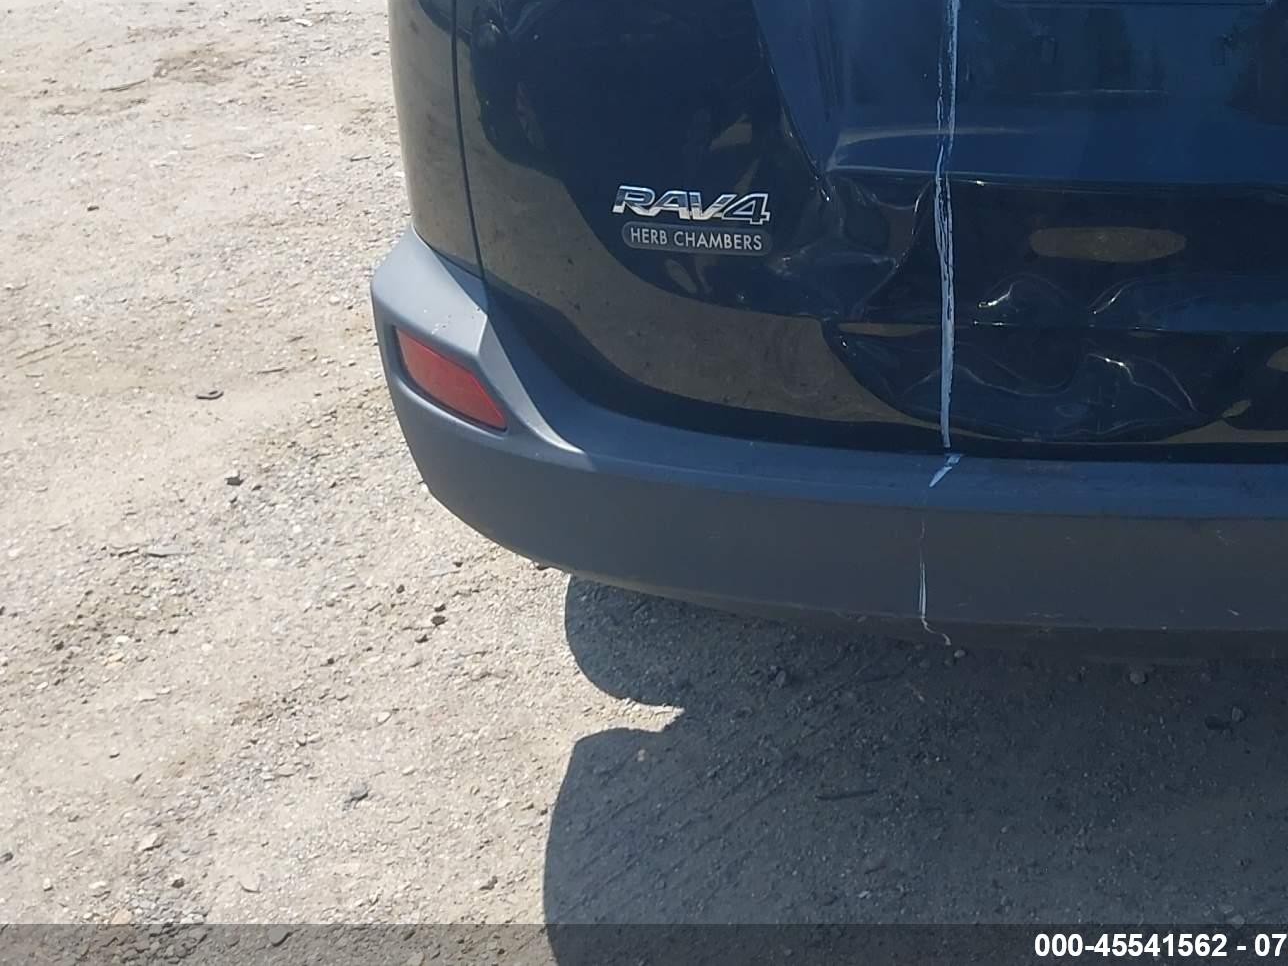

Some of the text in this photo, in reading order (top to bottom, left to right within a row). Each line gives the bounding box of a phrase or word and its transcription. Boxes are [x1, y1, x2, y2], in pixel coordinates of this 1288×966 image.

[612, 185, 771, 225] RAV4
[630, 227, 762, 251] HERB CHAMBERS
